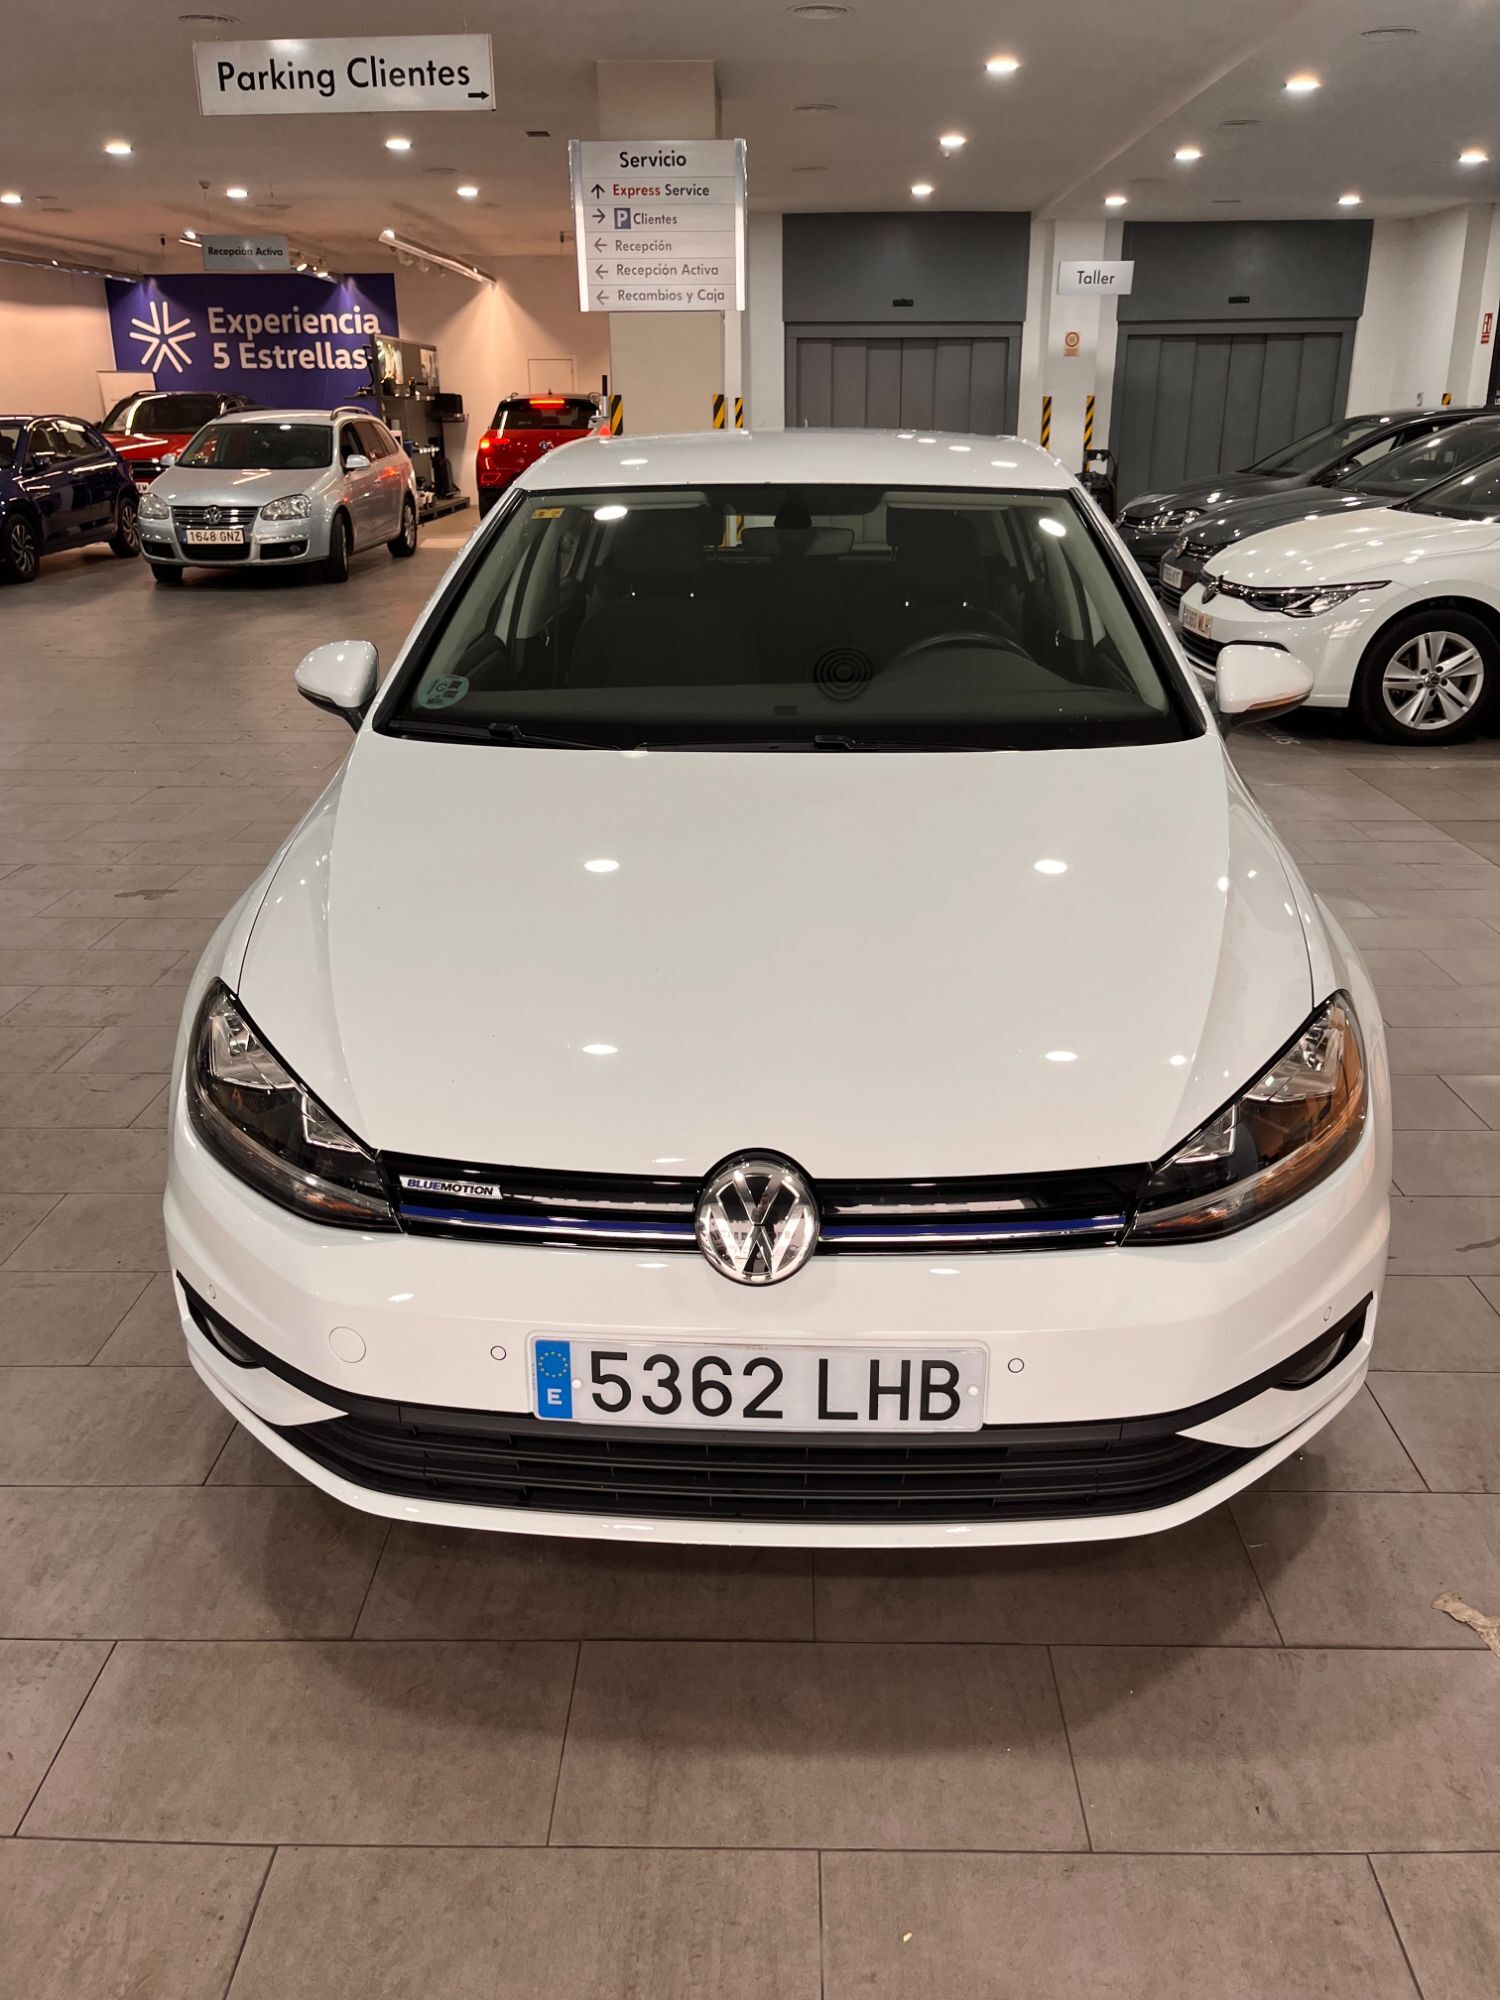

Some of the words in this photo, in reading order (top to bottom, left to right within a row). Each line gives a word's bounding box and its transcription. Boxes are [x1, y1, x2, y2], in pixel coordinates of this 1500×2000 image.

[217, 58, 336, 97] Parking
[347, 55, 470, 88] Clientes
[619, 150, 687, 168] Servicio
[613, 184, 661, 199] Express
[665, 184, 710, 196] Service
[616, 210, 629, 228] P
[633, 213, 678, 225] Clientes
[208, 246, 253, 258] Recepción
[256, 247, 283, 257] Activa
[615, 240, 672, 253] Recepción
[616, 264, 677, 278] Recepción
[681, 264, 719, 275] Activa
[1077, 270, 1115, 285] Taller
[618, 289, 682, 301] Recambios
[686, 293, 693, 303] y
[697, 289, 725, 303] Caja
[207, 306, 381, 341] Experiencia
[213, 342, 231, 369] 5
[239, 341, 368, 370] Estrellas
[190, 531, 217, 542] 1648
[219, 531, 241, 542] GNZ
[407, 1178, 494, 1196] BLUEMOTION
[547, 1388, 562, 1405] E
[591, 1350, 784, 1418] 5362
[817, 1358, 961, 1421] LHB
